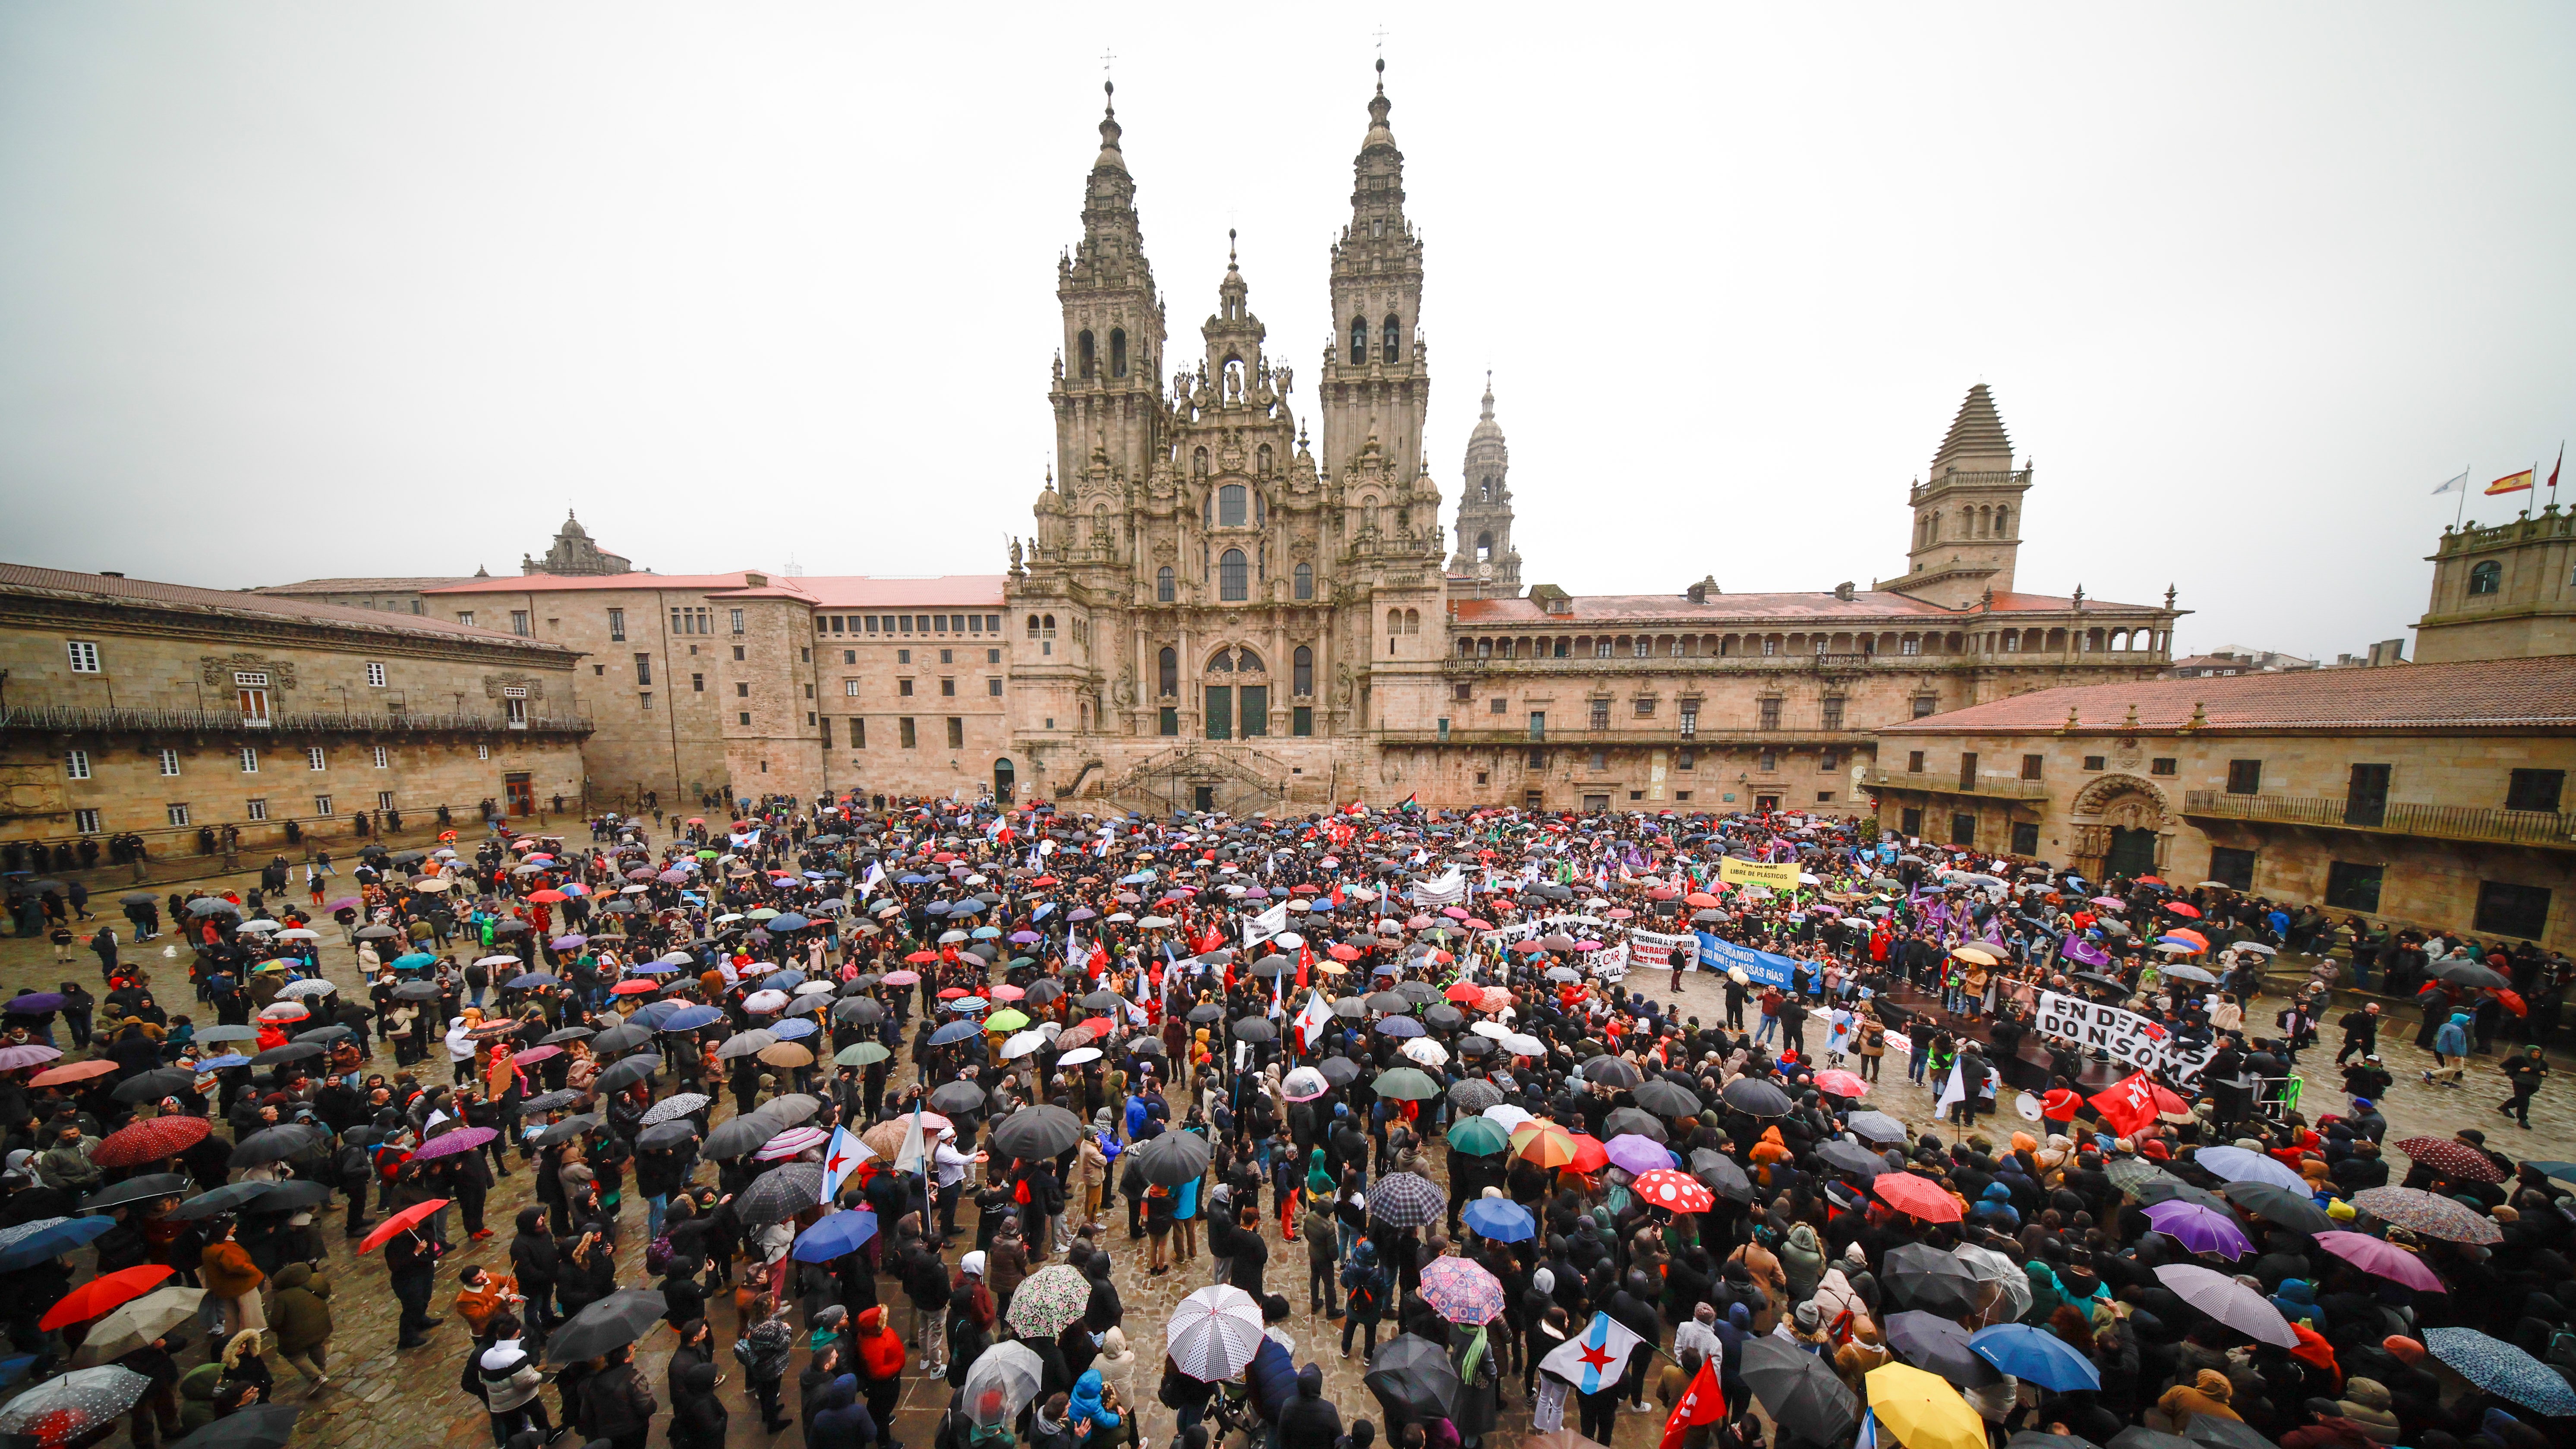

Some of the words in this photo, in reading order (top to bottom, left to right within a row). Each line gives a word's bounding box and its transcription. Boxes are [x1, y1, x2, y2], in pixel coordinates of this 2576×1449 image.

[1714, 941, 1755, 963] DEFENDAMOS
[1713, 951, 1725, 966] MAR
[1725, 957, 1728, 967] E
[1766, 968, 1784, 983] RÍAS
[2054, 998, 2087, 1021] EN
[2045, 1014, 2078, 1037] DO
